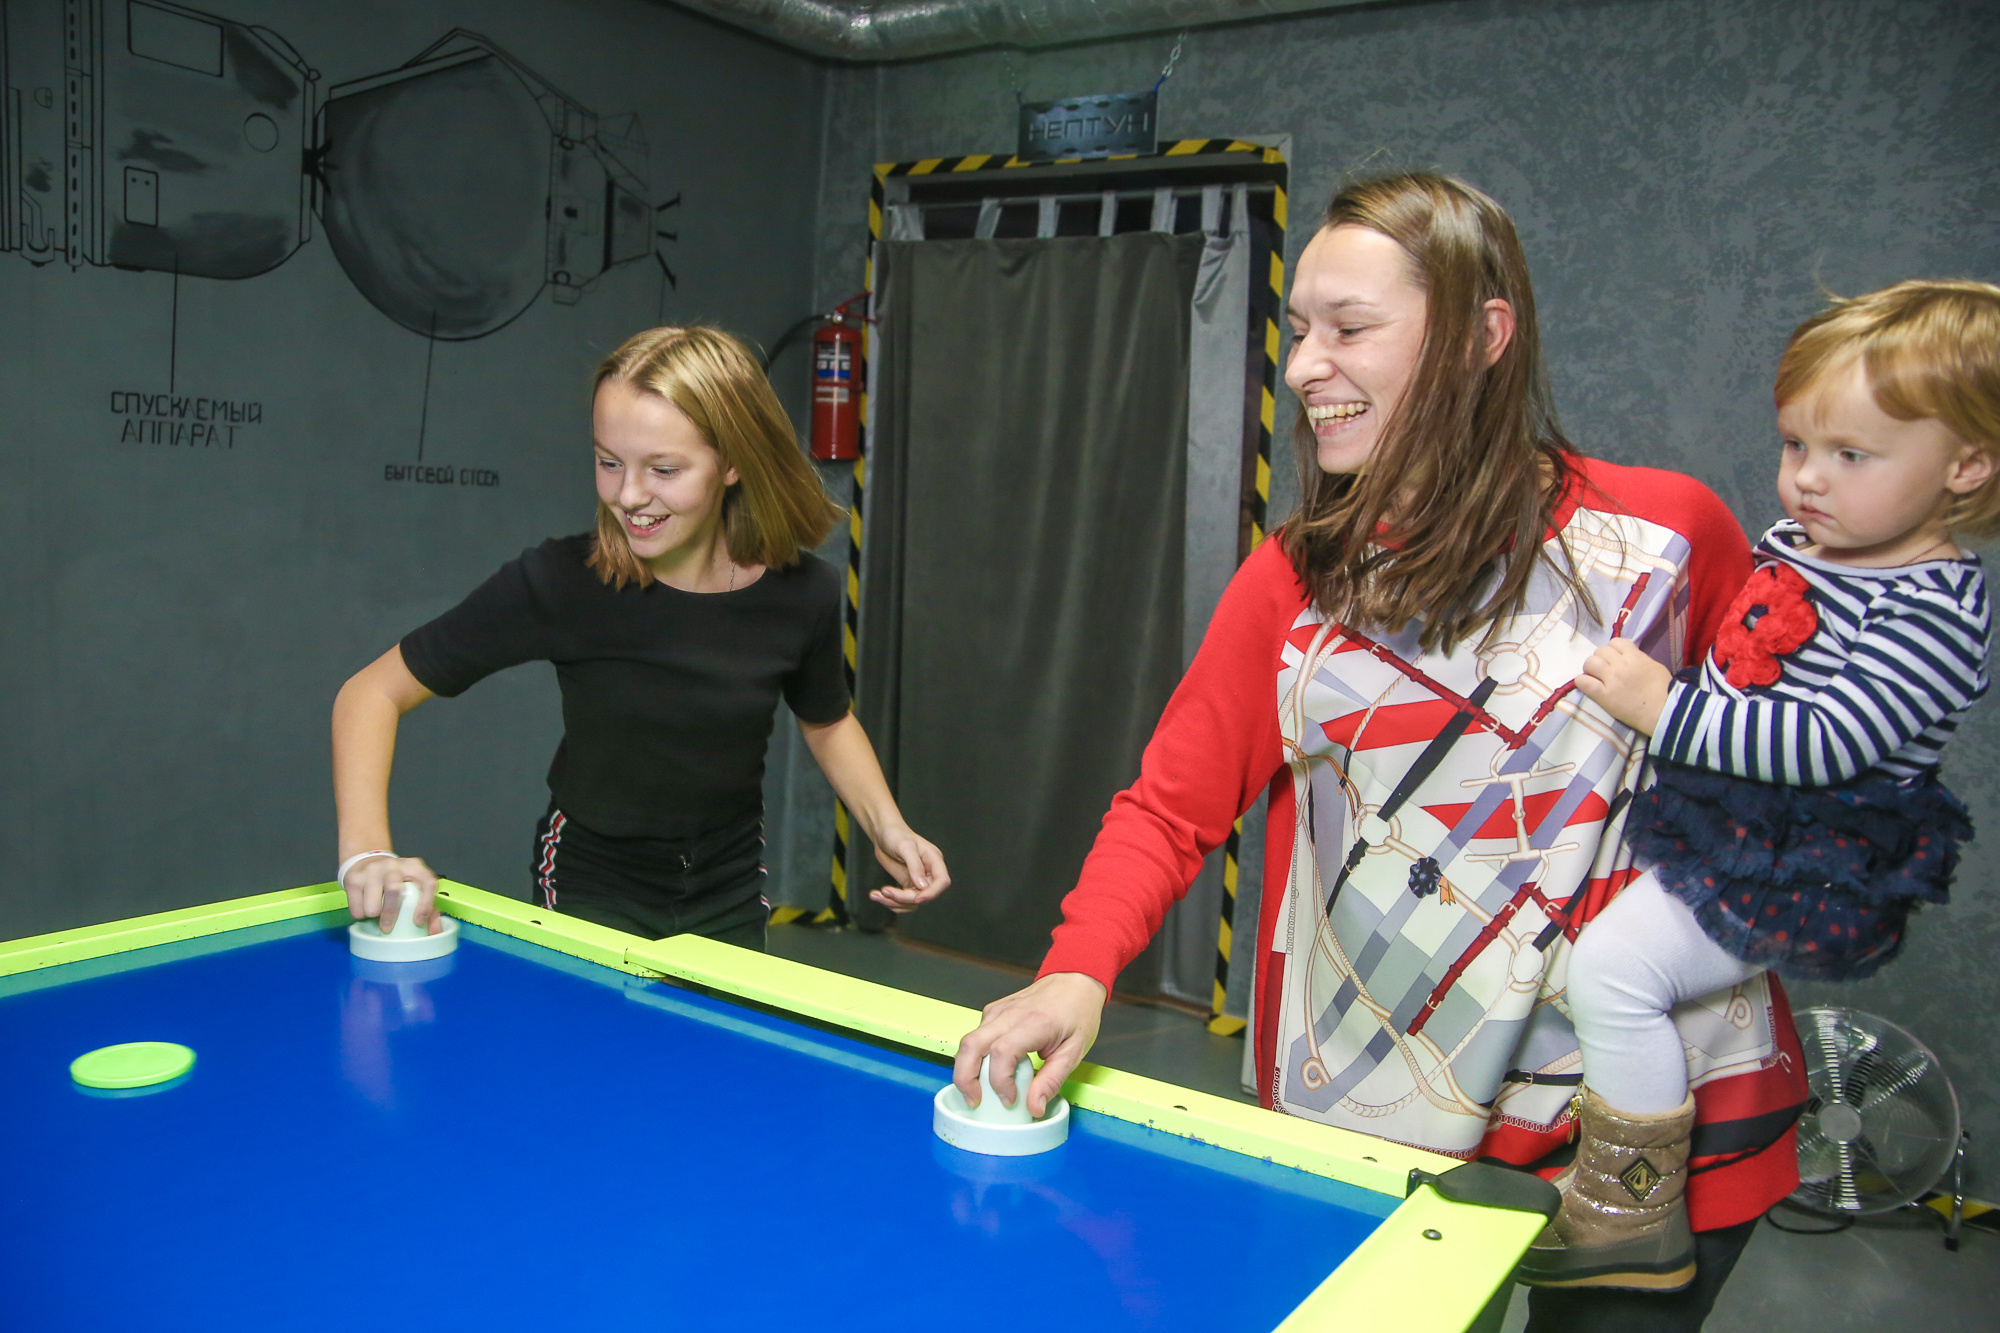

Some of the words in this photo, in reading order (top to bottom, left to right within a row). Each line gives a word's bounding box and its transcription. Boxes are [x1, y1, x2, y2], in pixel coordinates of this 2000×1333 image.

[1028, 112, 1149, 142] НЕПТУН
[110, 391, 262, 425] СПУСКАЕМЫЙ
[120, 419, 242, 449] АППАРАТ
